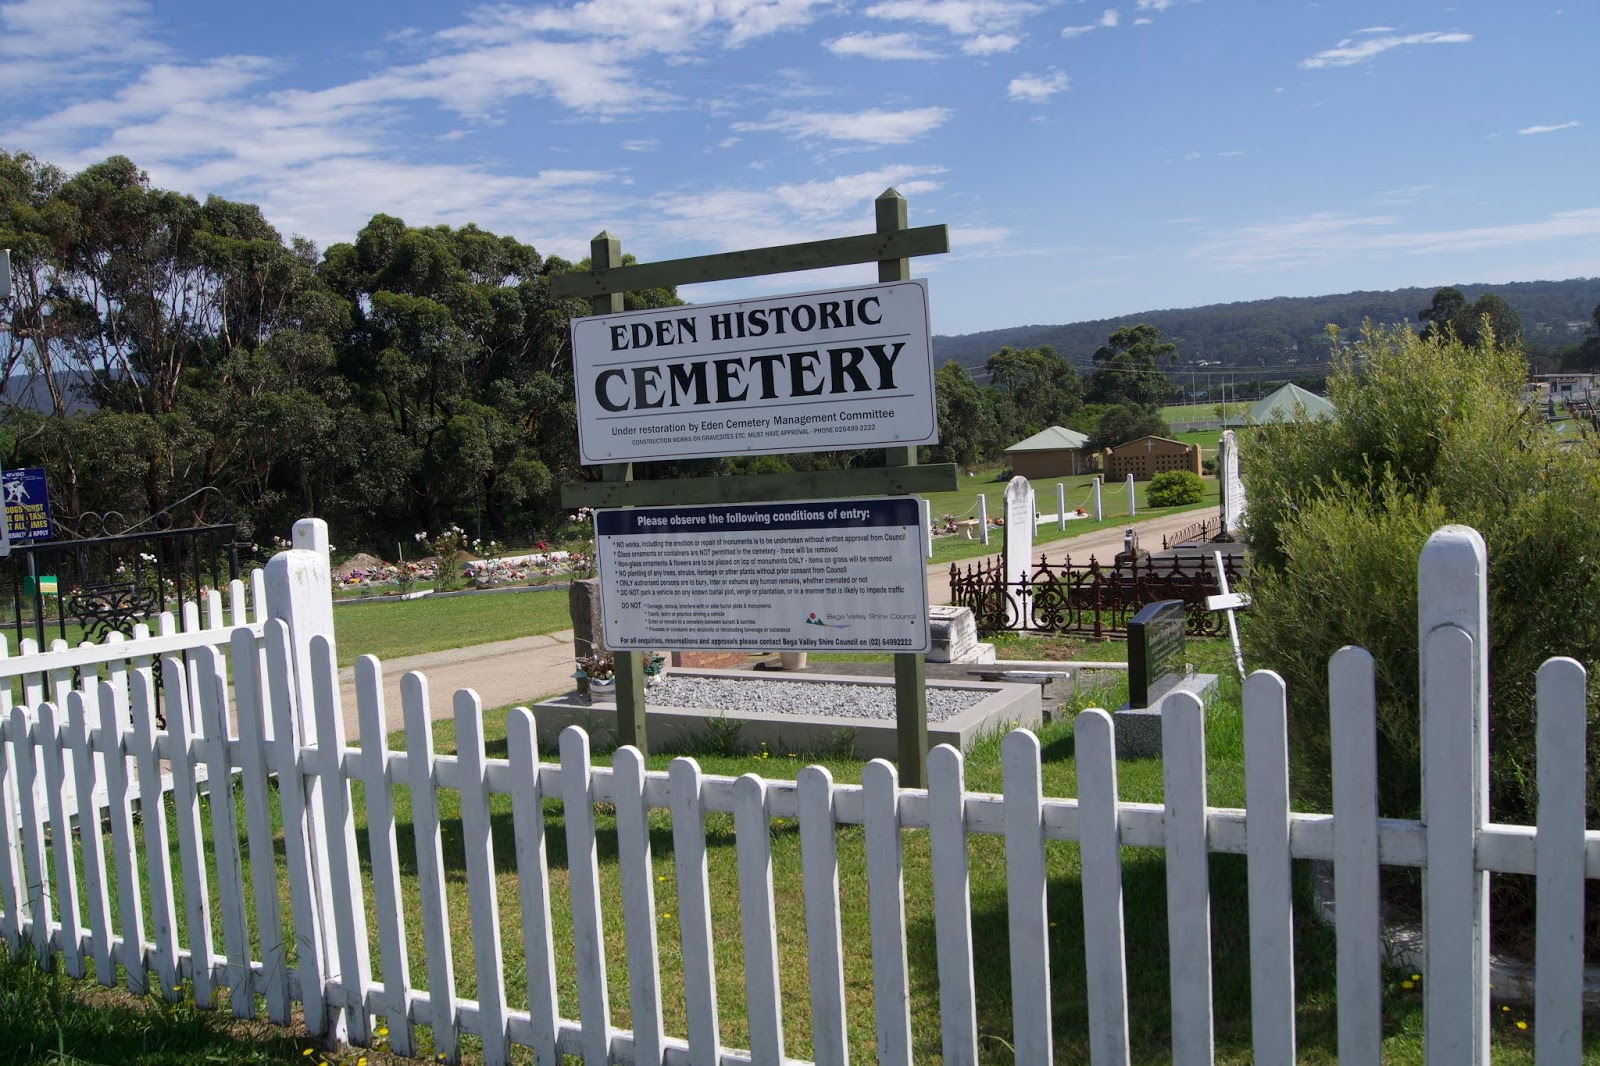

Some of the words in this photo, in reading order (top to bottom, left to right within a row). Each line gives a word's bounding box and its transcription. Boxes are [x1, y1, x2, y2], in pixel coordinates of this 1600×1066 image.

[609, 316, 698, 350] EDEN
[710, 296, 882, 340] HISTORIC
[594, 342, 905, 412] CEMETERY
[611, 426, 636, 435] Under
[639, 423, 685, 433] restoration
[688, 422, 698, 432] by
[701, 420, 723, 430] Eden
[725, 418, 769, 428] Cemetery
[773, 412, 836, 425] Management
[839, 409, 894, 420] Committee
[637, 516, 667, 526] Please
[670, 515, 706, 525] observe
[708, 514, 724, 524] the
[726, 512, 770, 524] following
[773, 510, 825, 521] conditions
[827, 509, 837, 519] of
[840, 508, 870, 520] entry:
[845, 534, 869, 543] approval
[712, 548, 736, 556] permitted
[628, 570, 646, 578] planting
[844, 587, 858, 595] likely
[866, 586, 887, 595] impede
[739, 638, 758, 646] please
[782, 638, 797, 646] Bega
[799, 638, 817, 646] Valley
[869, 638, 880, 646] (02)
